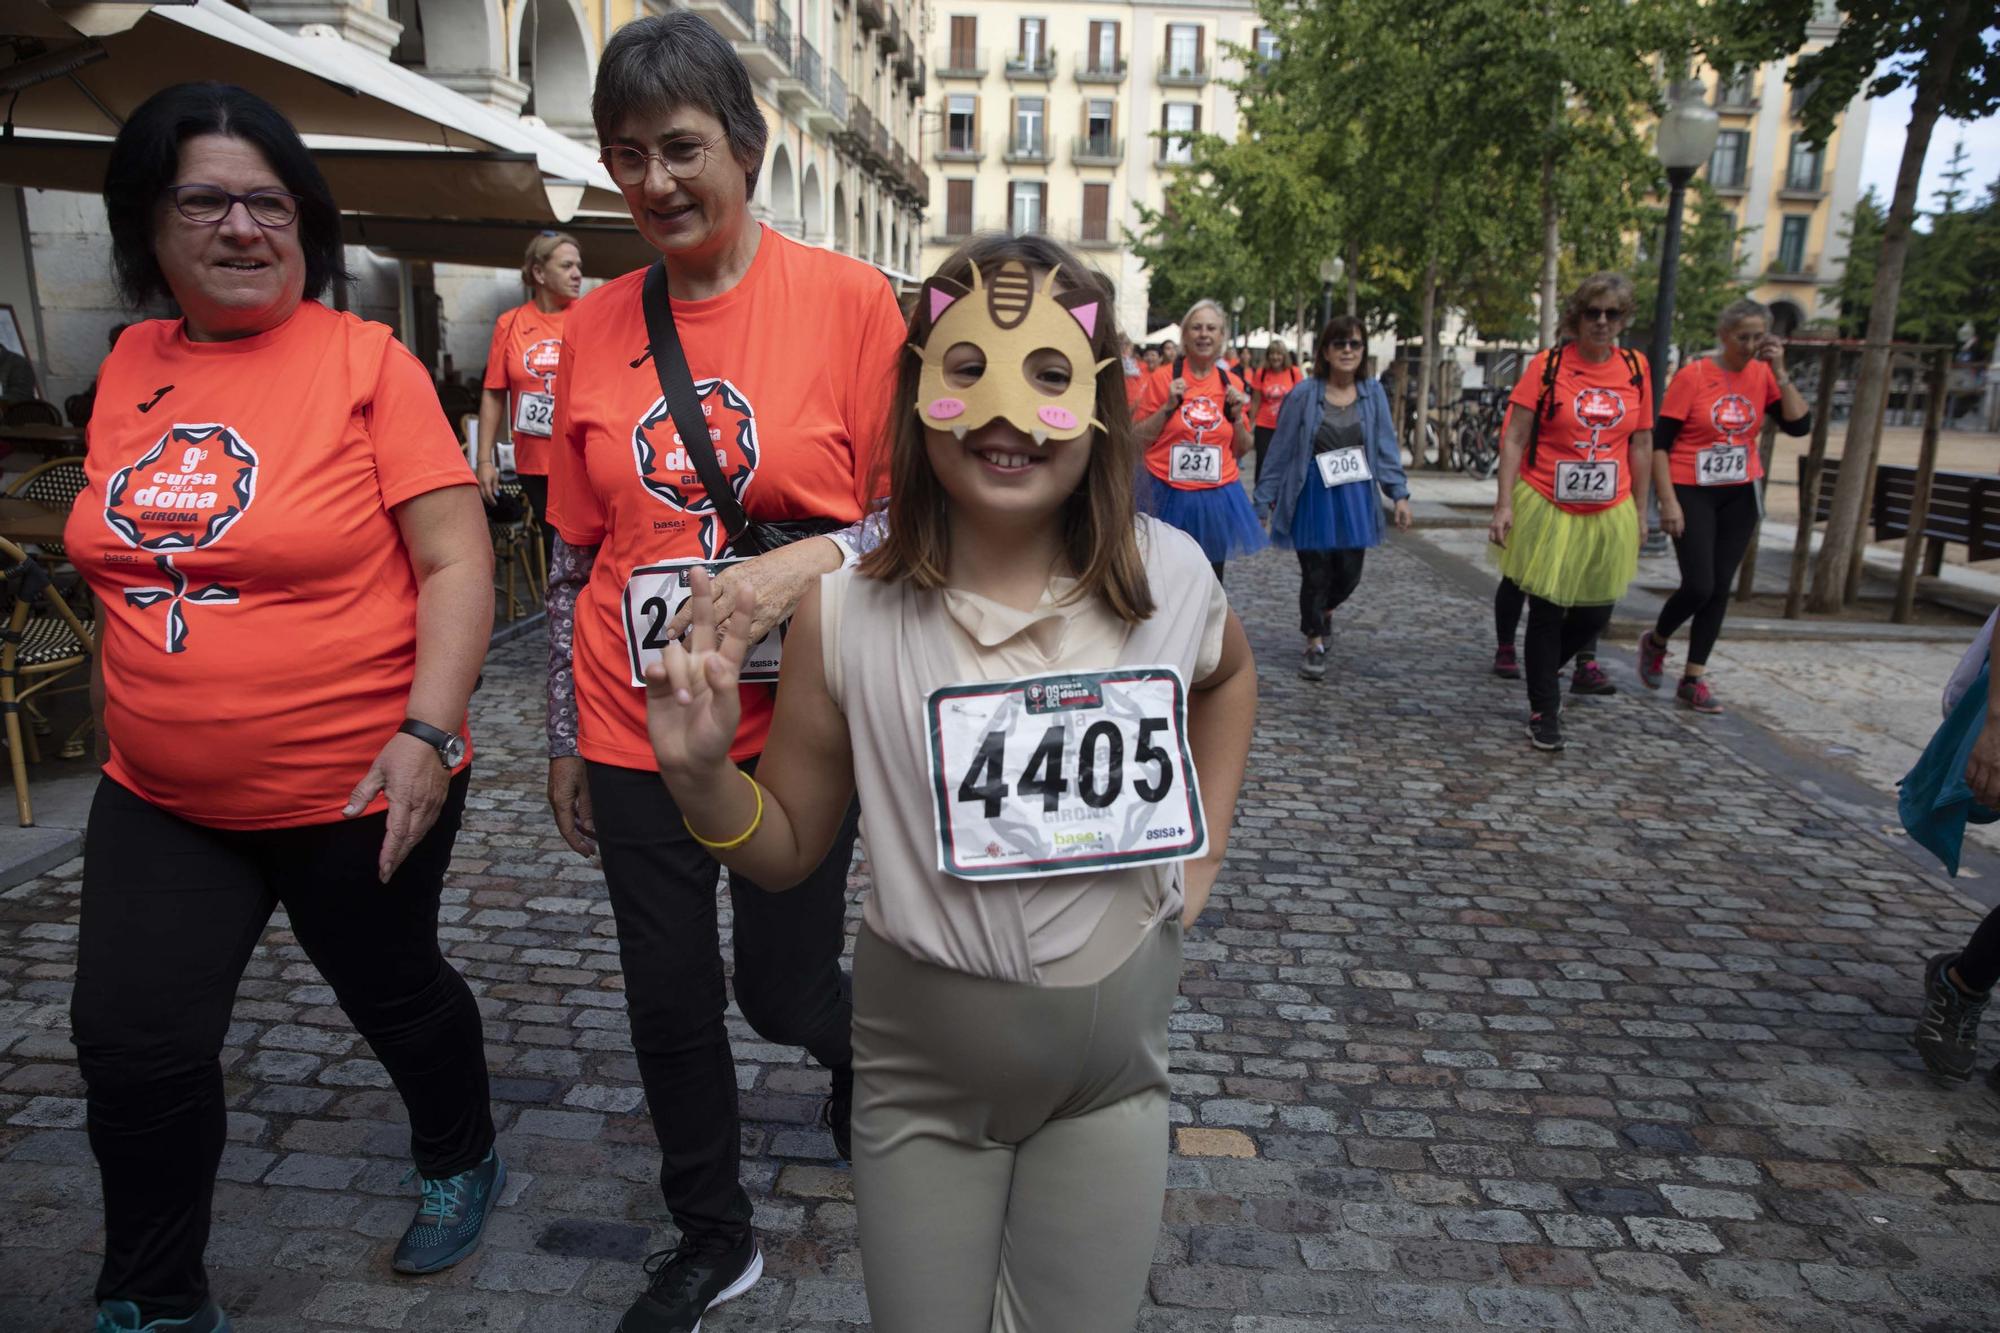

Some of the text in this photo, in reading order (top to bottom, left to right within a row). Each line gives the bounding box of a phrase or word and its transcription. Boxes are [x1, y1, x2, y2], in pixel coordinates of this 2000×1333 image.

[1179, 454, 1213, 471] 231
[1330, 455, 1359, 475] 206
[1702, 452, 1744, 474] 4378
[152, 471, 218, 486] cursa
[1566, 471, 1606, 491] 212
[134, 486, 218, 510] dona
[140, 511, 199, 523] GIRONA
[1045, 685, 1059, 699] 09
[1060, 689, 1089, 698] dona
[957, 717, 1174, 819] 4405
